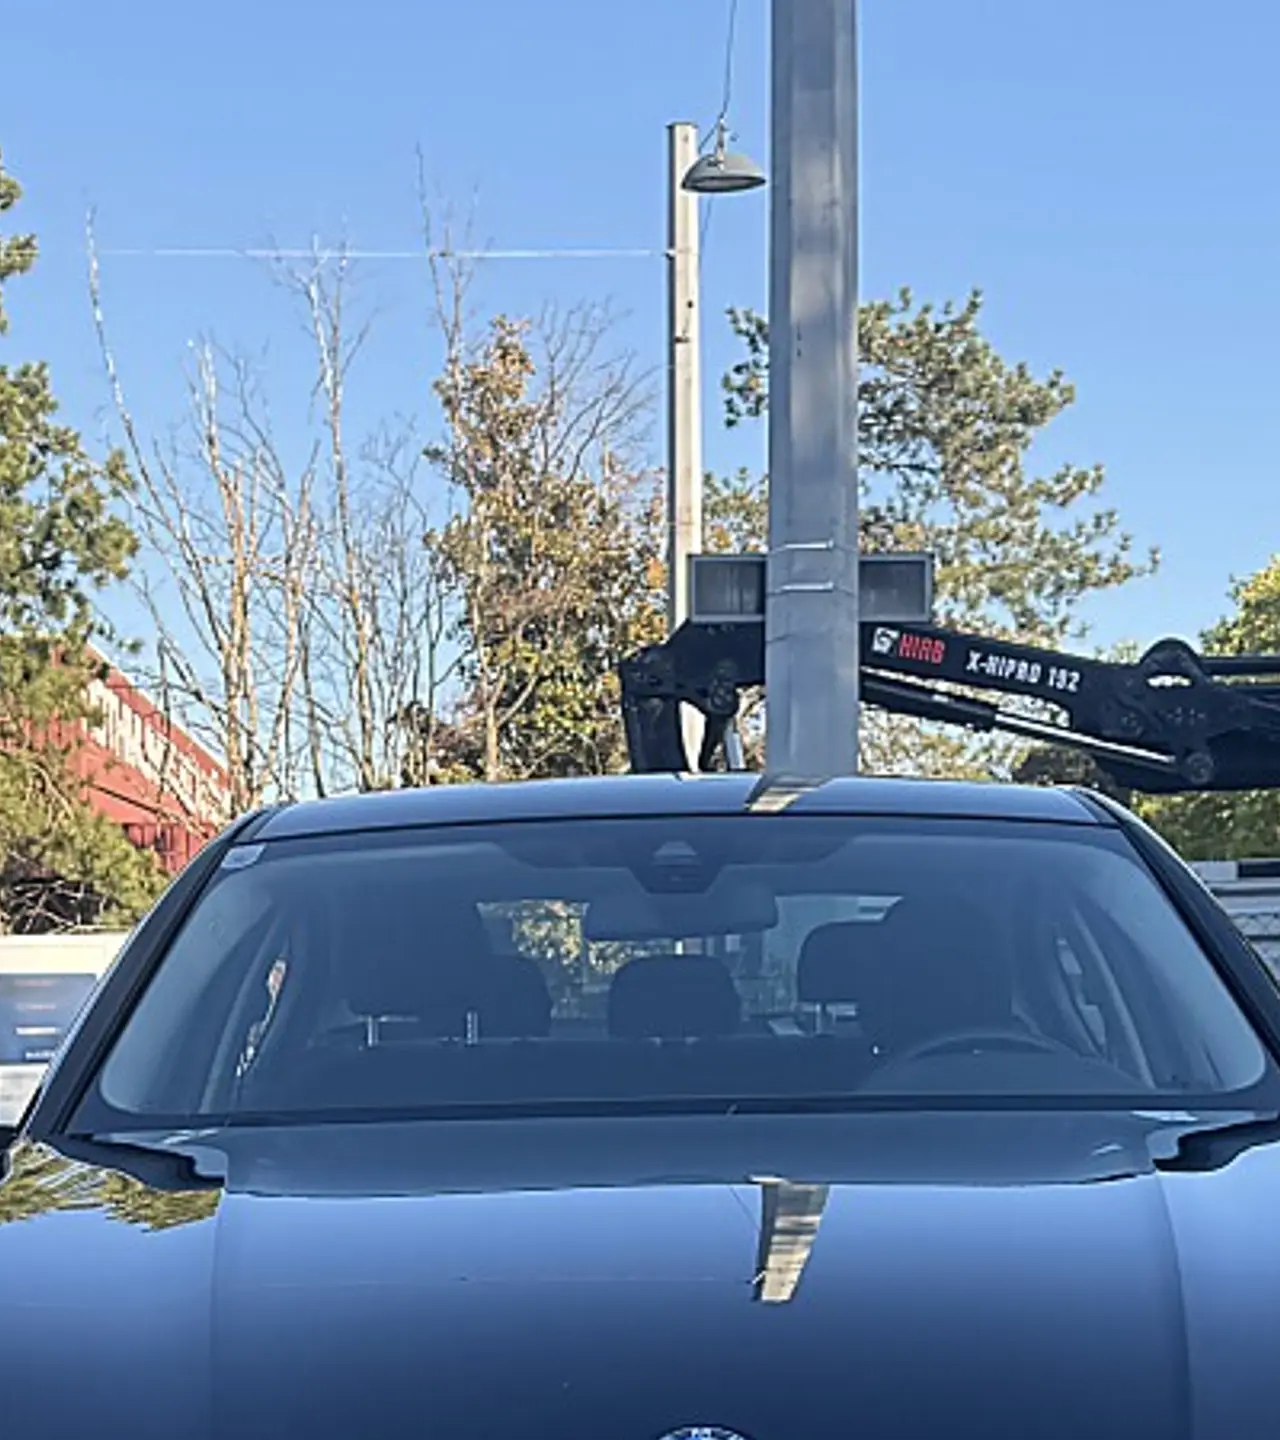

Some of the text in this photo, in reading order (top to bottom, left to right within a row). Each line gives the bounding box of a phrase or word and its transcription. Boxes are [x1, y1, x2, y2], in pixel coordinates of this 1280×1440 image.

[898, 634, 1080, 693] HIAB X-HIPRO 192
